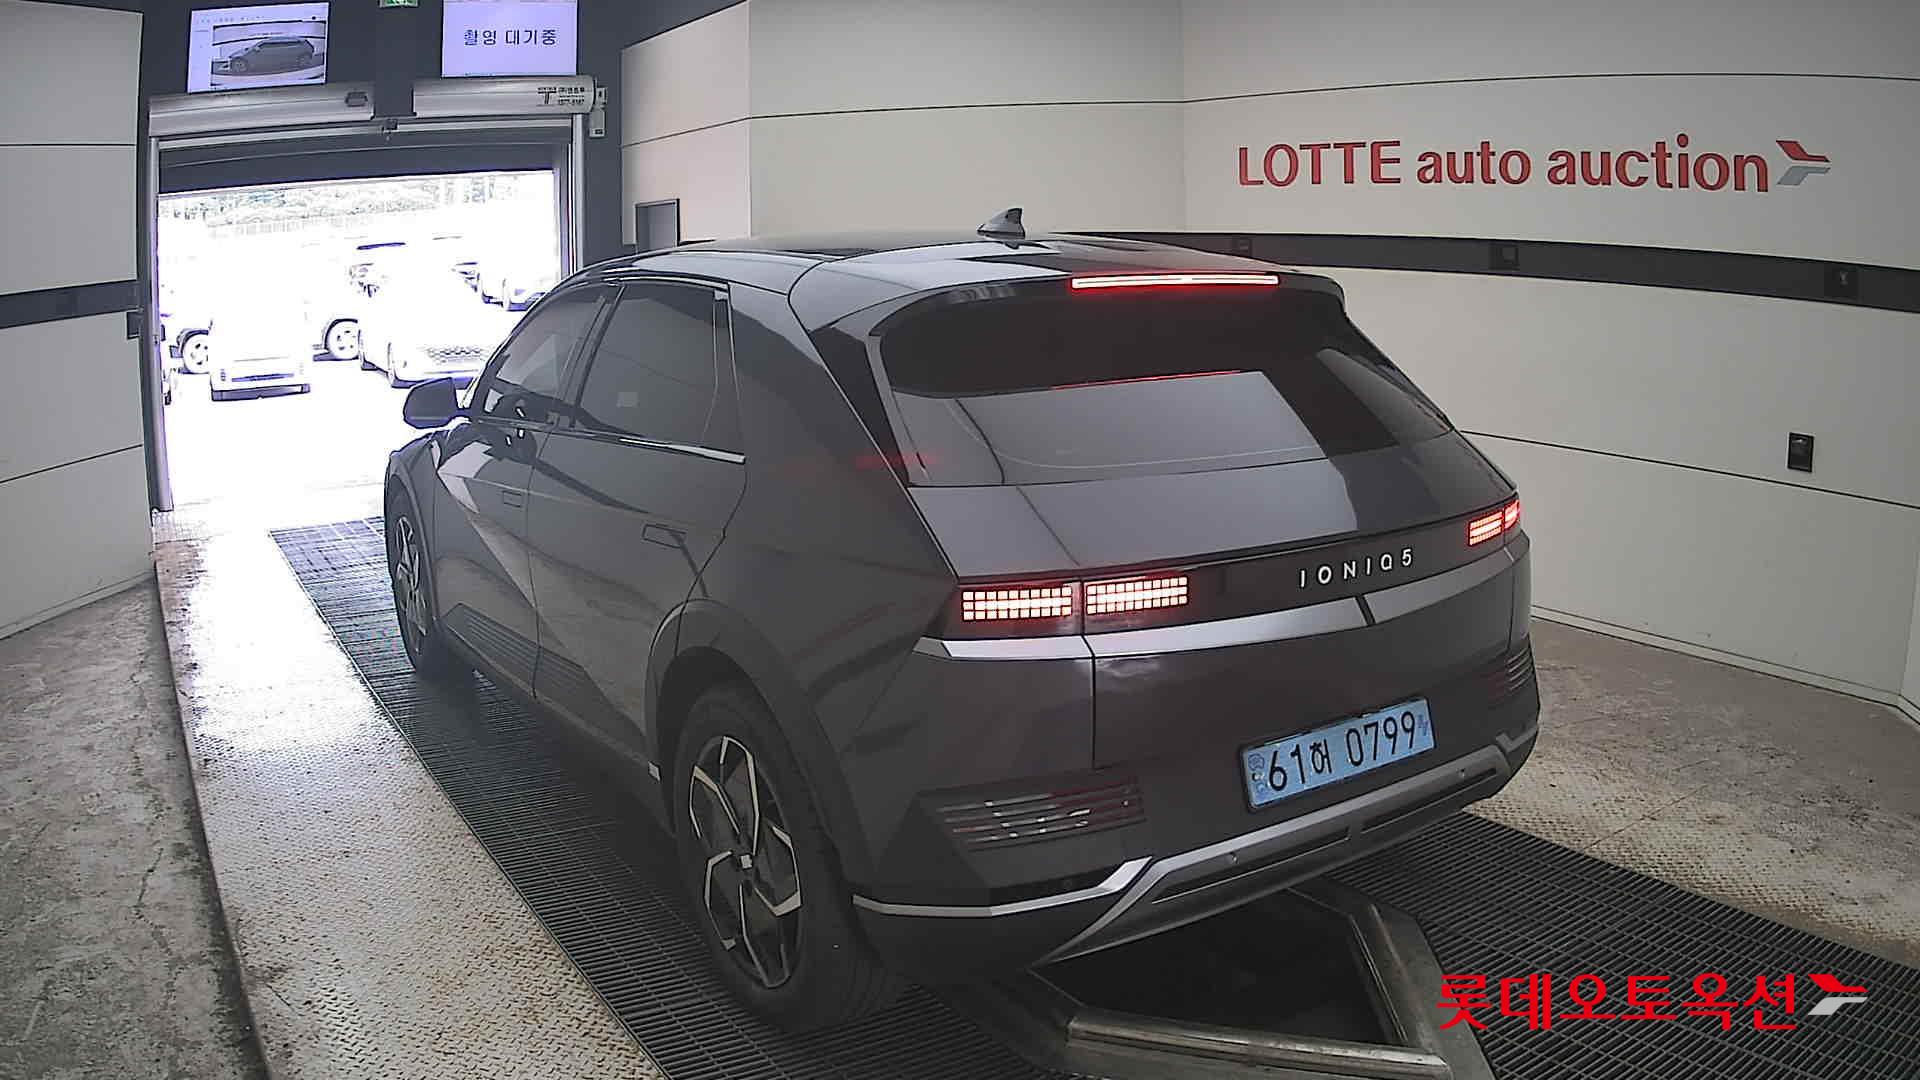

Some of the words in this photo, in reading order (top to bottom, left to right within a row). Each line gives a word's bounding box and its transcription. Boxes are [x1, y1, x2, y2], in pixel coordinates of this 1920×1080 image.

[505, 29, 557, 46] 대기중
[1239, 140, 1401, 186] LOTTE
[1416, 140, 1532, 185] auto
[1546, 133, 1770, 193] auction
[1268, 738, 1333, 792] 61허
[1345, 711, 1416, 767] 0799
